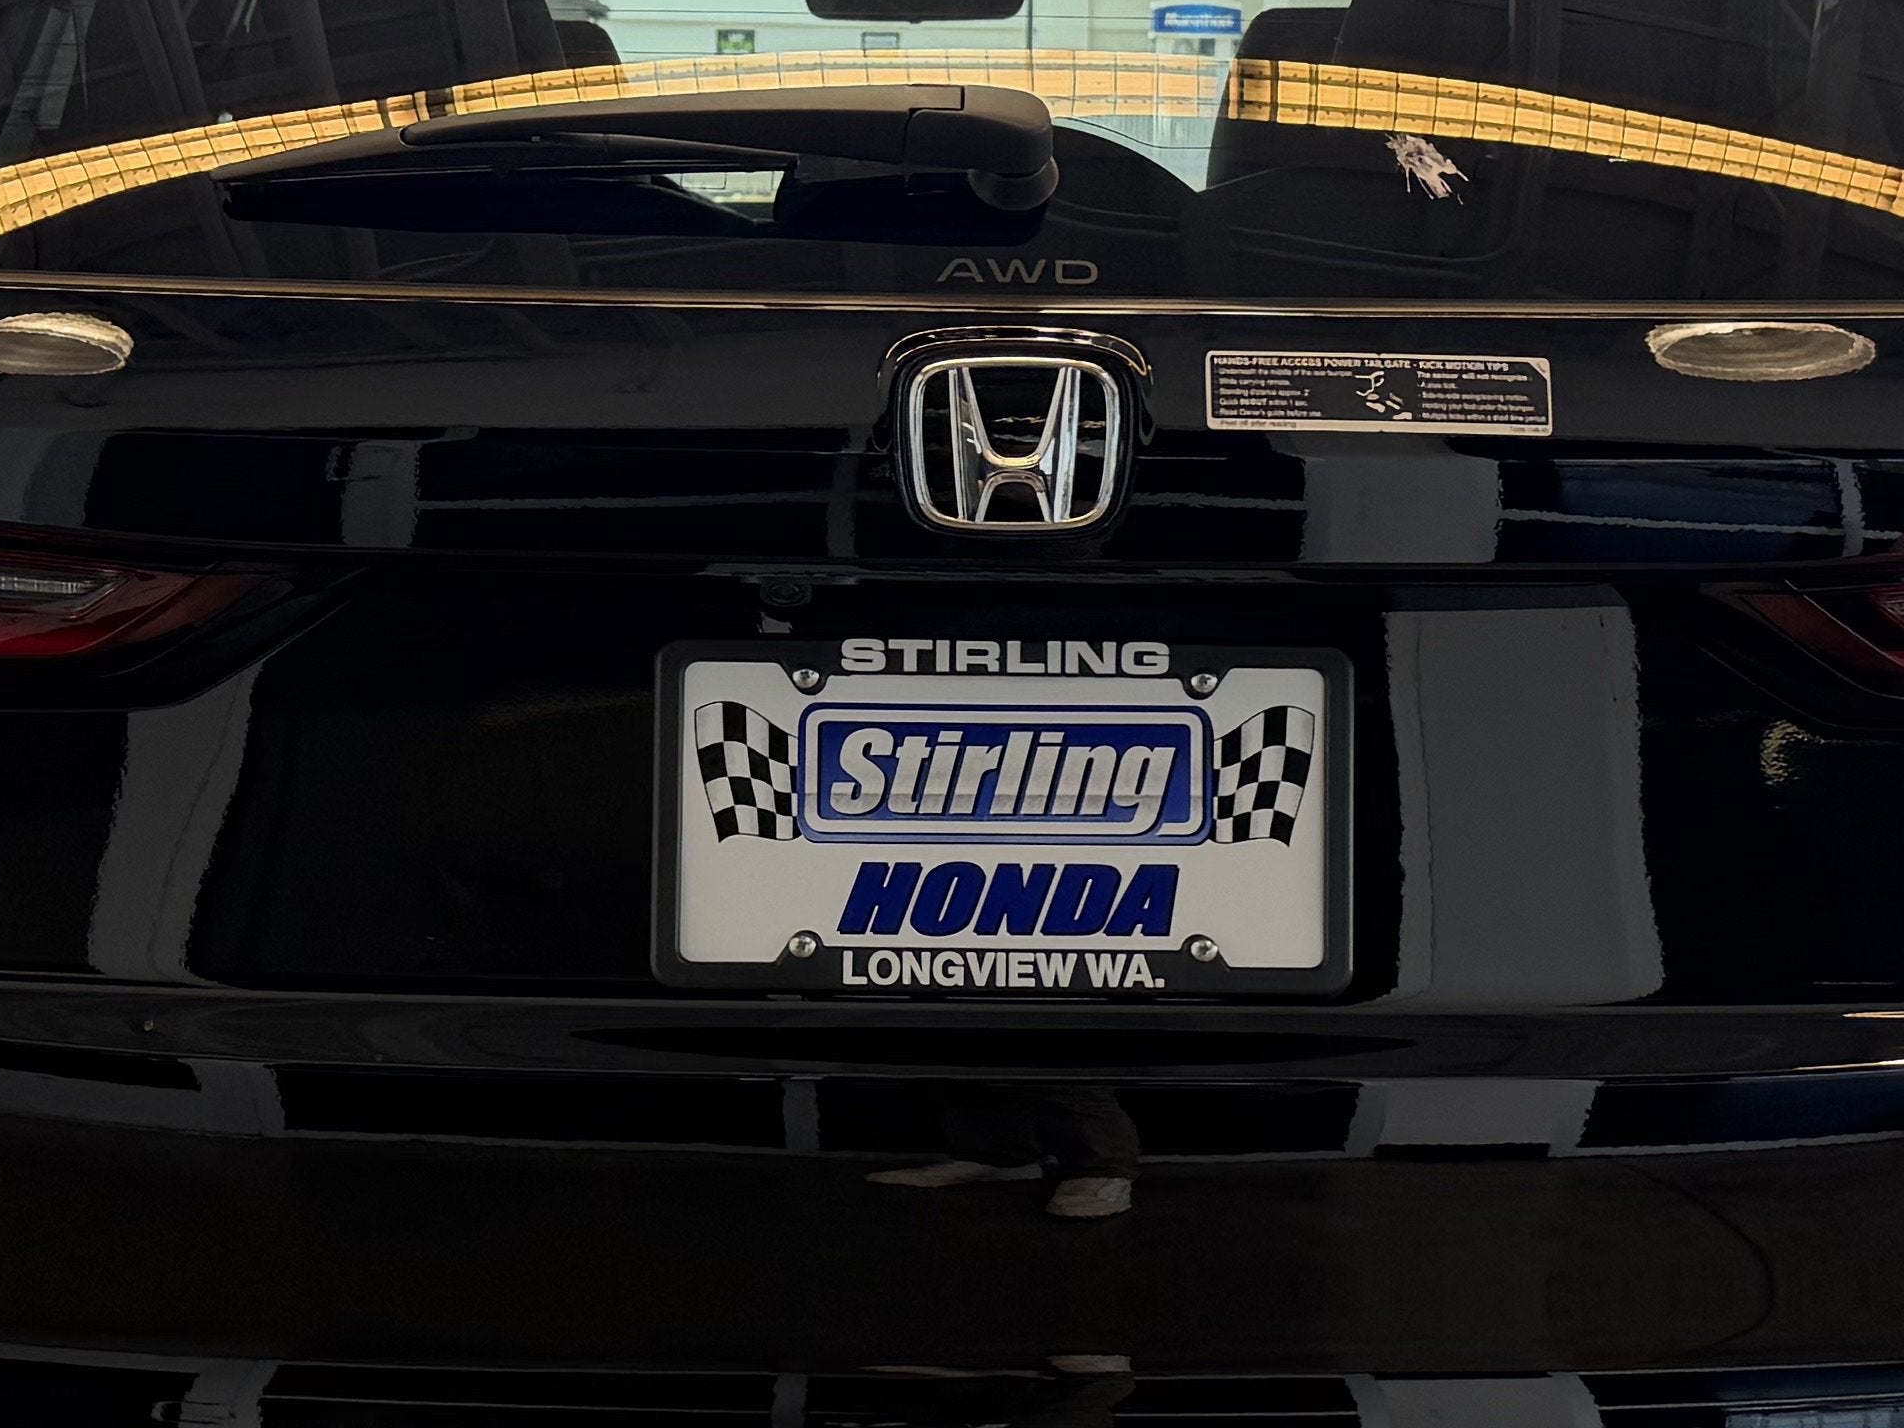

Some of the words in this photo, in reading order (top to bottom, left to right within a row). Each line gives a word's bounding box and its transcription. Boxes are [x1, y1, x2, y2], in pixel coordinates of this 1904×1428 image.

[936, 258, 1098, 284] AWD
[1487, 363, 1509, 372] TIPS
[840, 638, 1171, 676] STIRLING
[829, 727, 1176, 832] Stirling
[837, 861, 1180, 937] HONDA
[841, 949, 1079, 988] LONGVIEW
[1084, 954, 1166, 989] WA.
